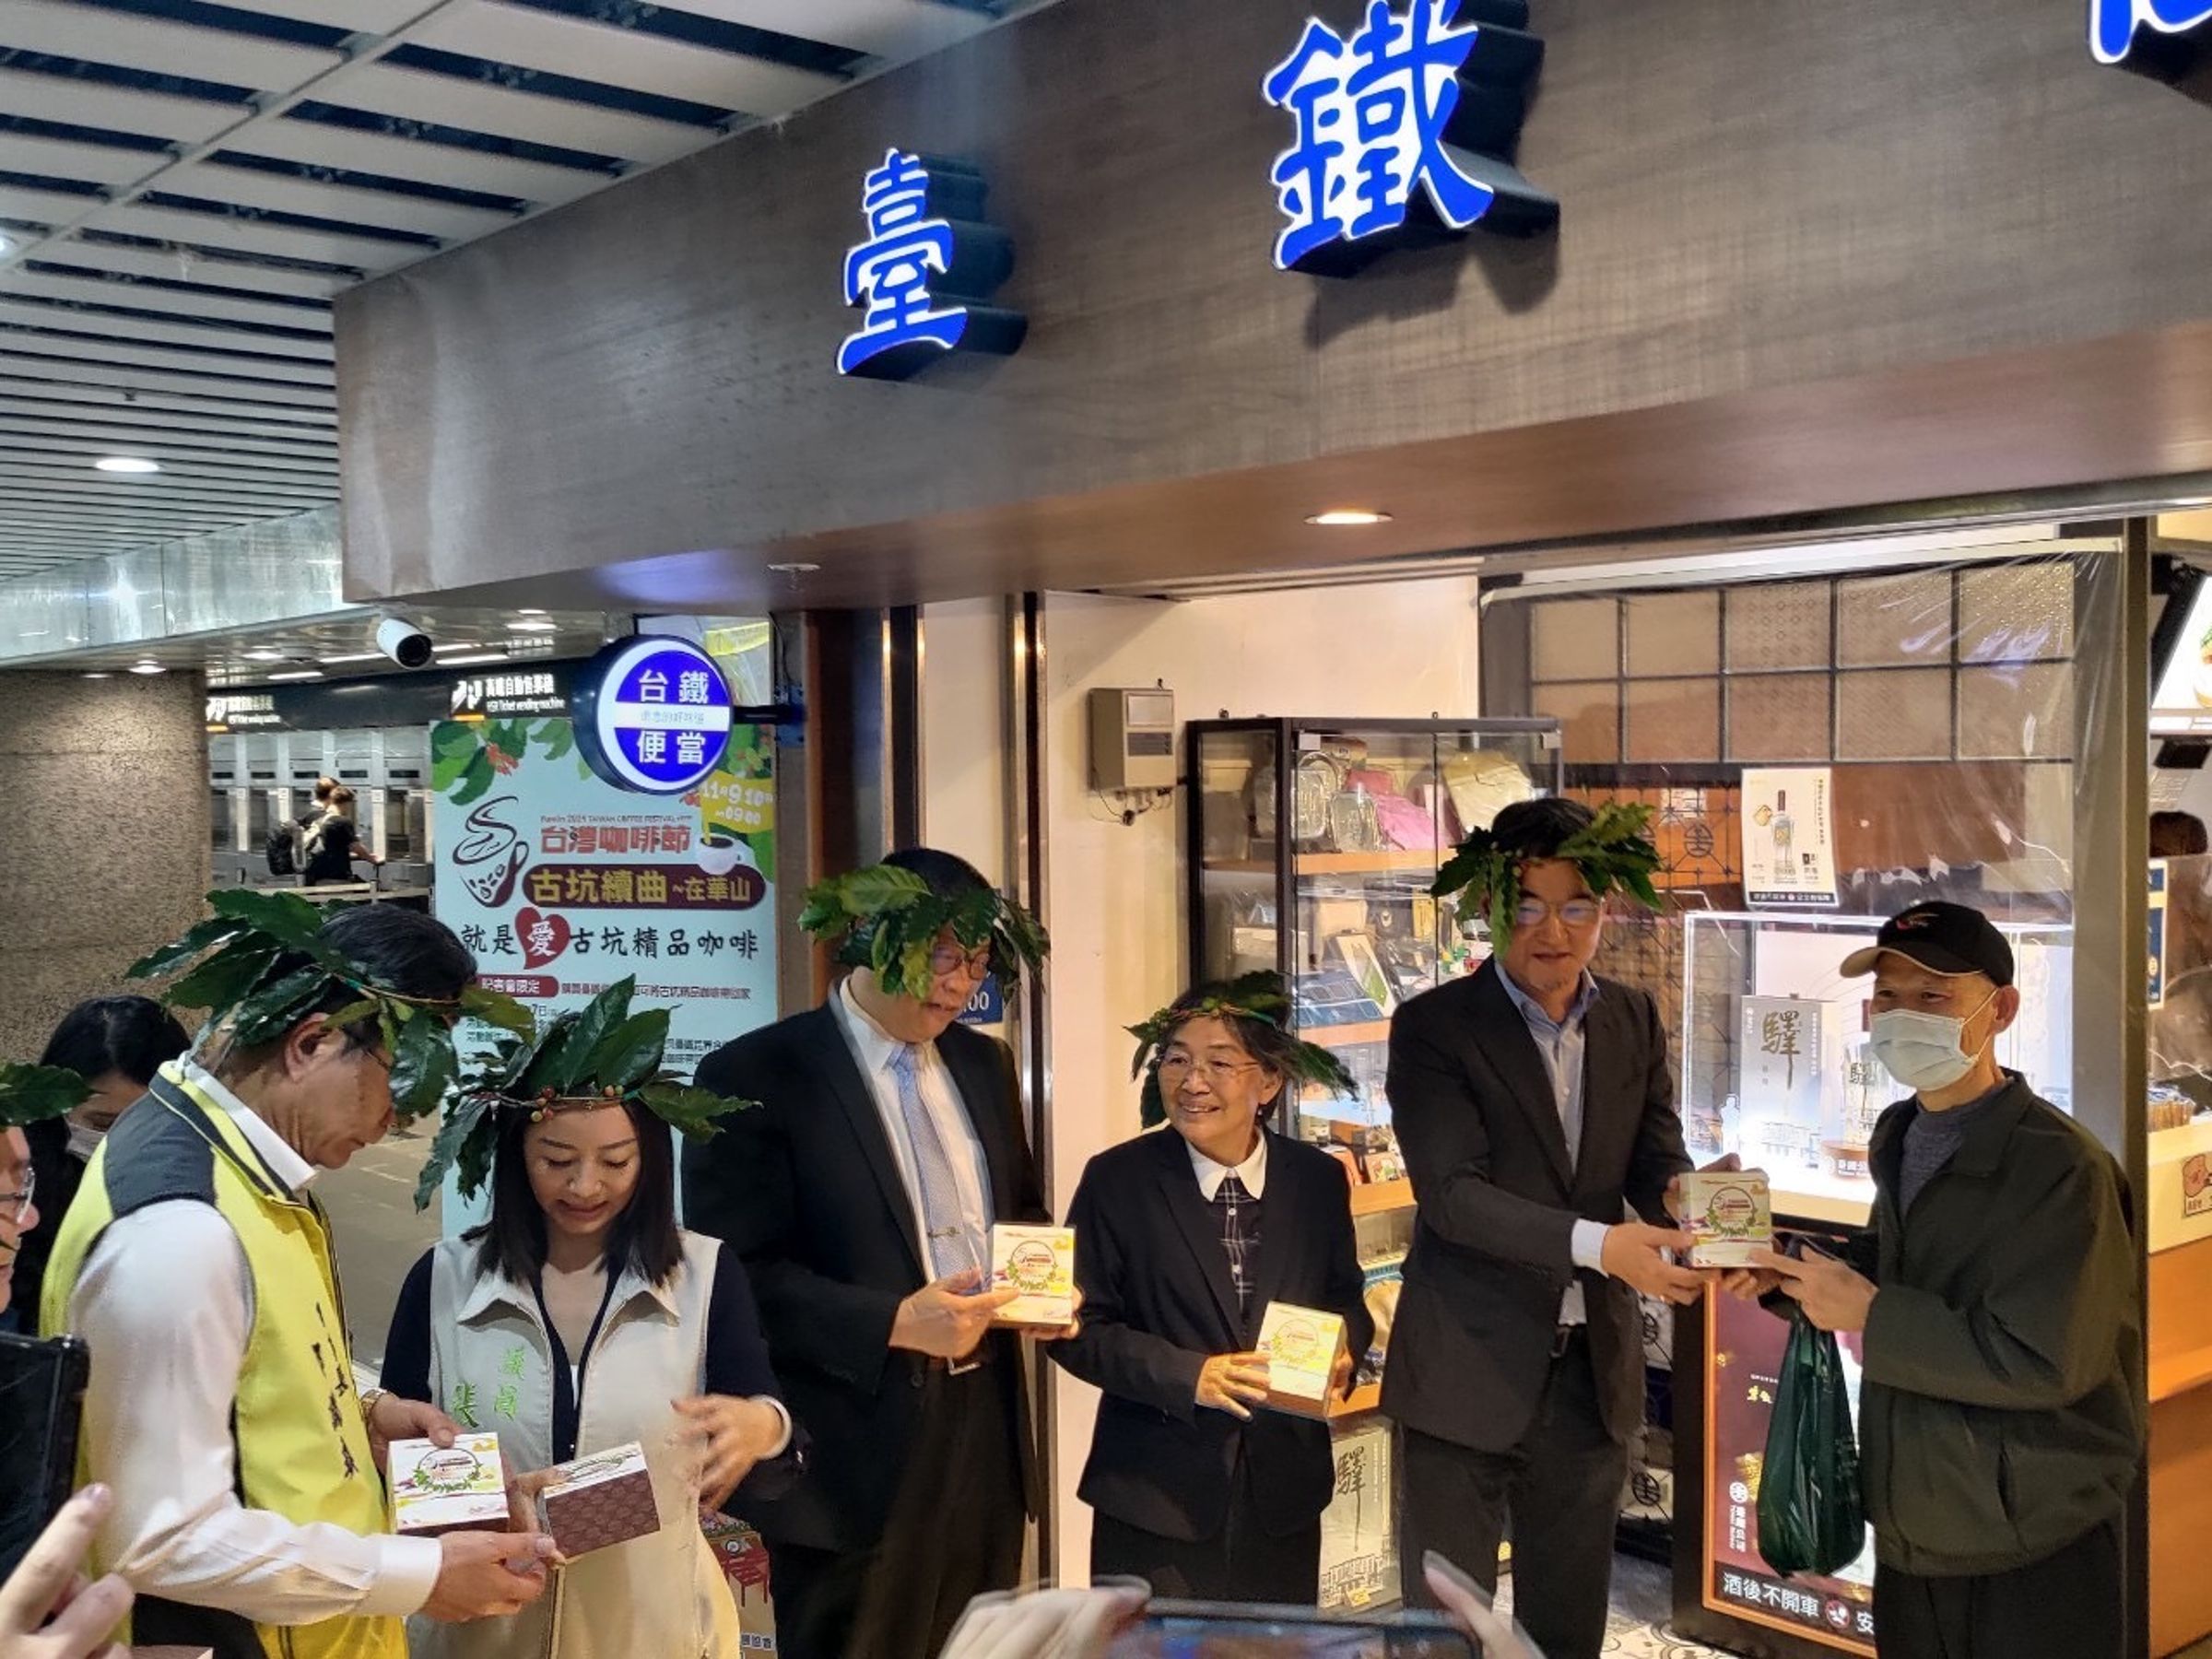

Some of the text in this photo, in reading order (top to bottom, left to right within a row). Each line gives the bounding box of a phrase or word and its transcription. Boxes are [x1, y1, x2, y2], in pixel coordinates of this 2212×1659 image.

[638, 669, 709, 704] 台鐵
[636, 731, 706, 765] 便當
[540, 825, 691, 854] 台灣咖啡節
[1722, 1571, 1820, 1618] 酒後不開車
